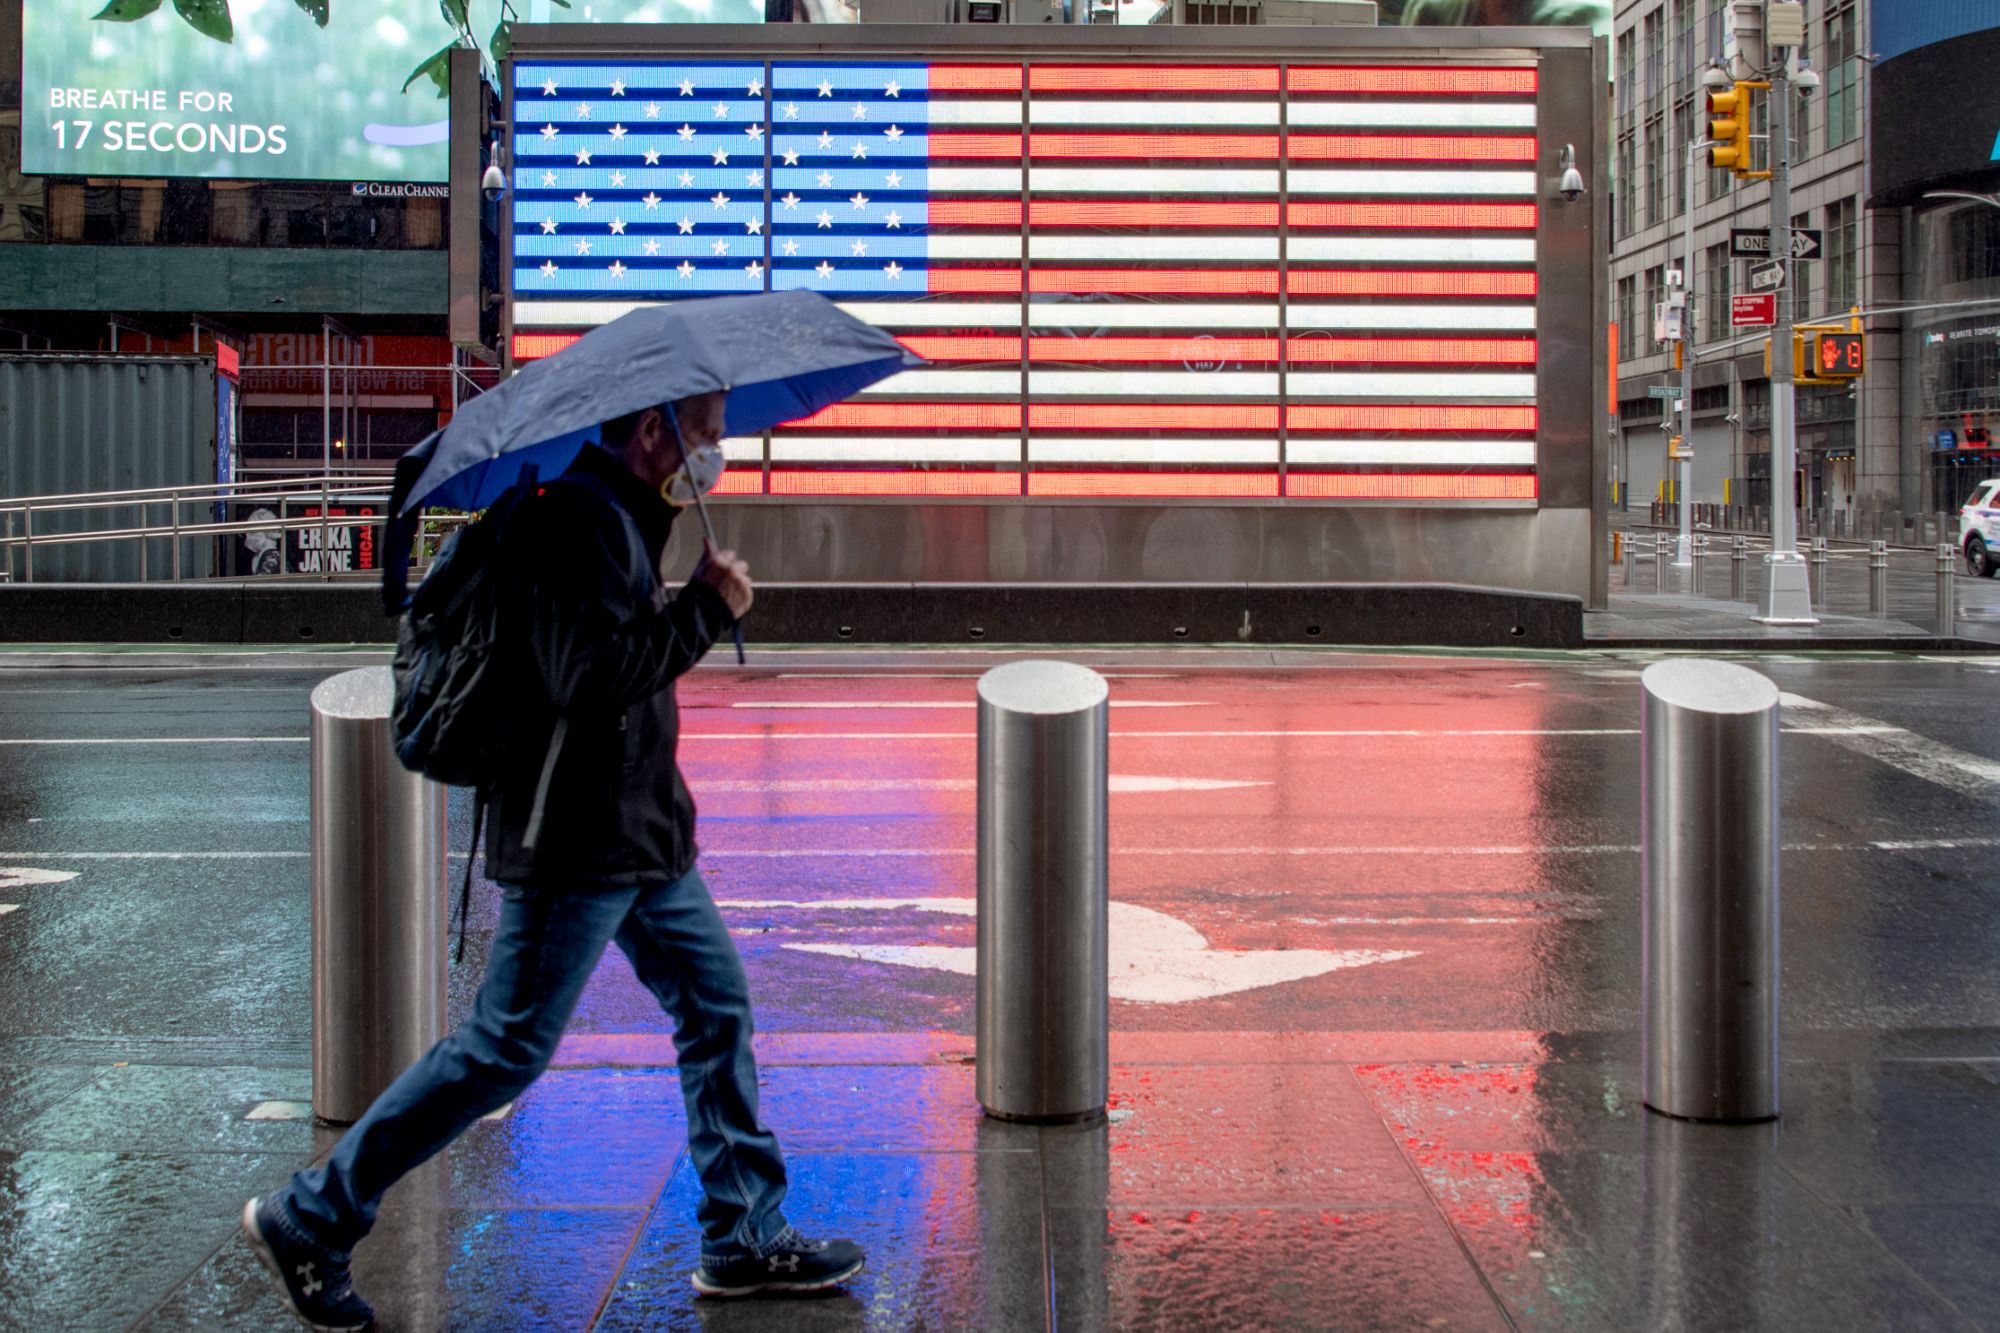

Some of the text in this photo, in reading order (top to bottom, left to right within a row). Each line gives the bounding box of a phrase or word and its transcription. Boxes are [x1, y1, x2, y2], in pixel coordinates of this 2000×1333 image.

[50, 88, 233, 112] BREATHE FOR
[51, 120, 287, 155] 17 SECONDS
[369, 182, 449, 197] CLEARCHANNE
[1743, 237, 1807, 250] ONE AY
[1733, 305, 1754, 313] Anytime
[1742, 296, 1765, 305] STOPPING
[1847, 341, 1861, 368] 8
[299, 526, 352, 549] ERKA
